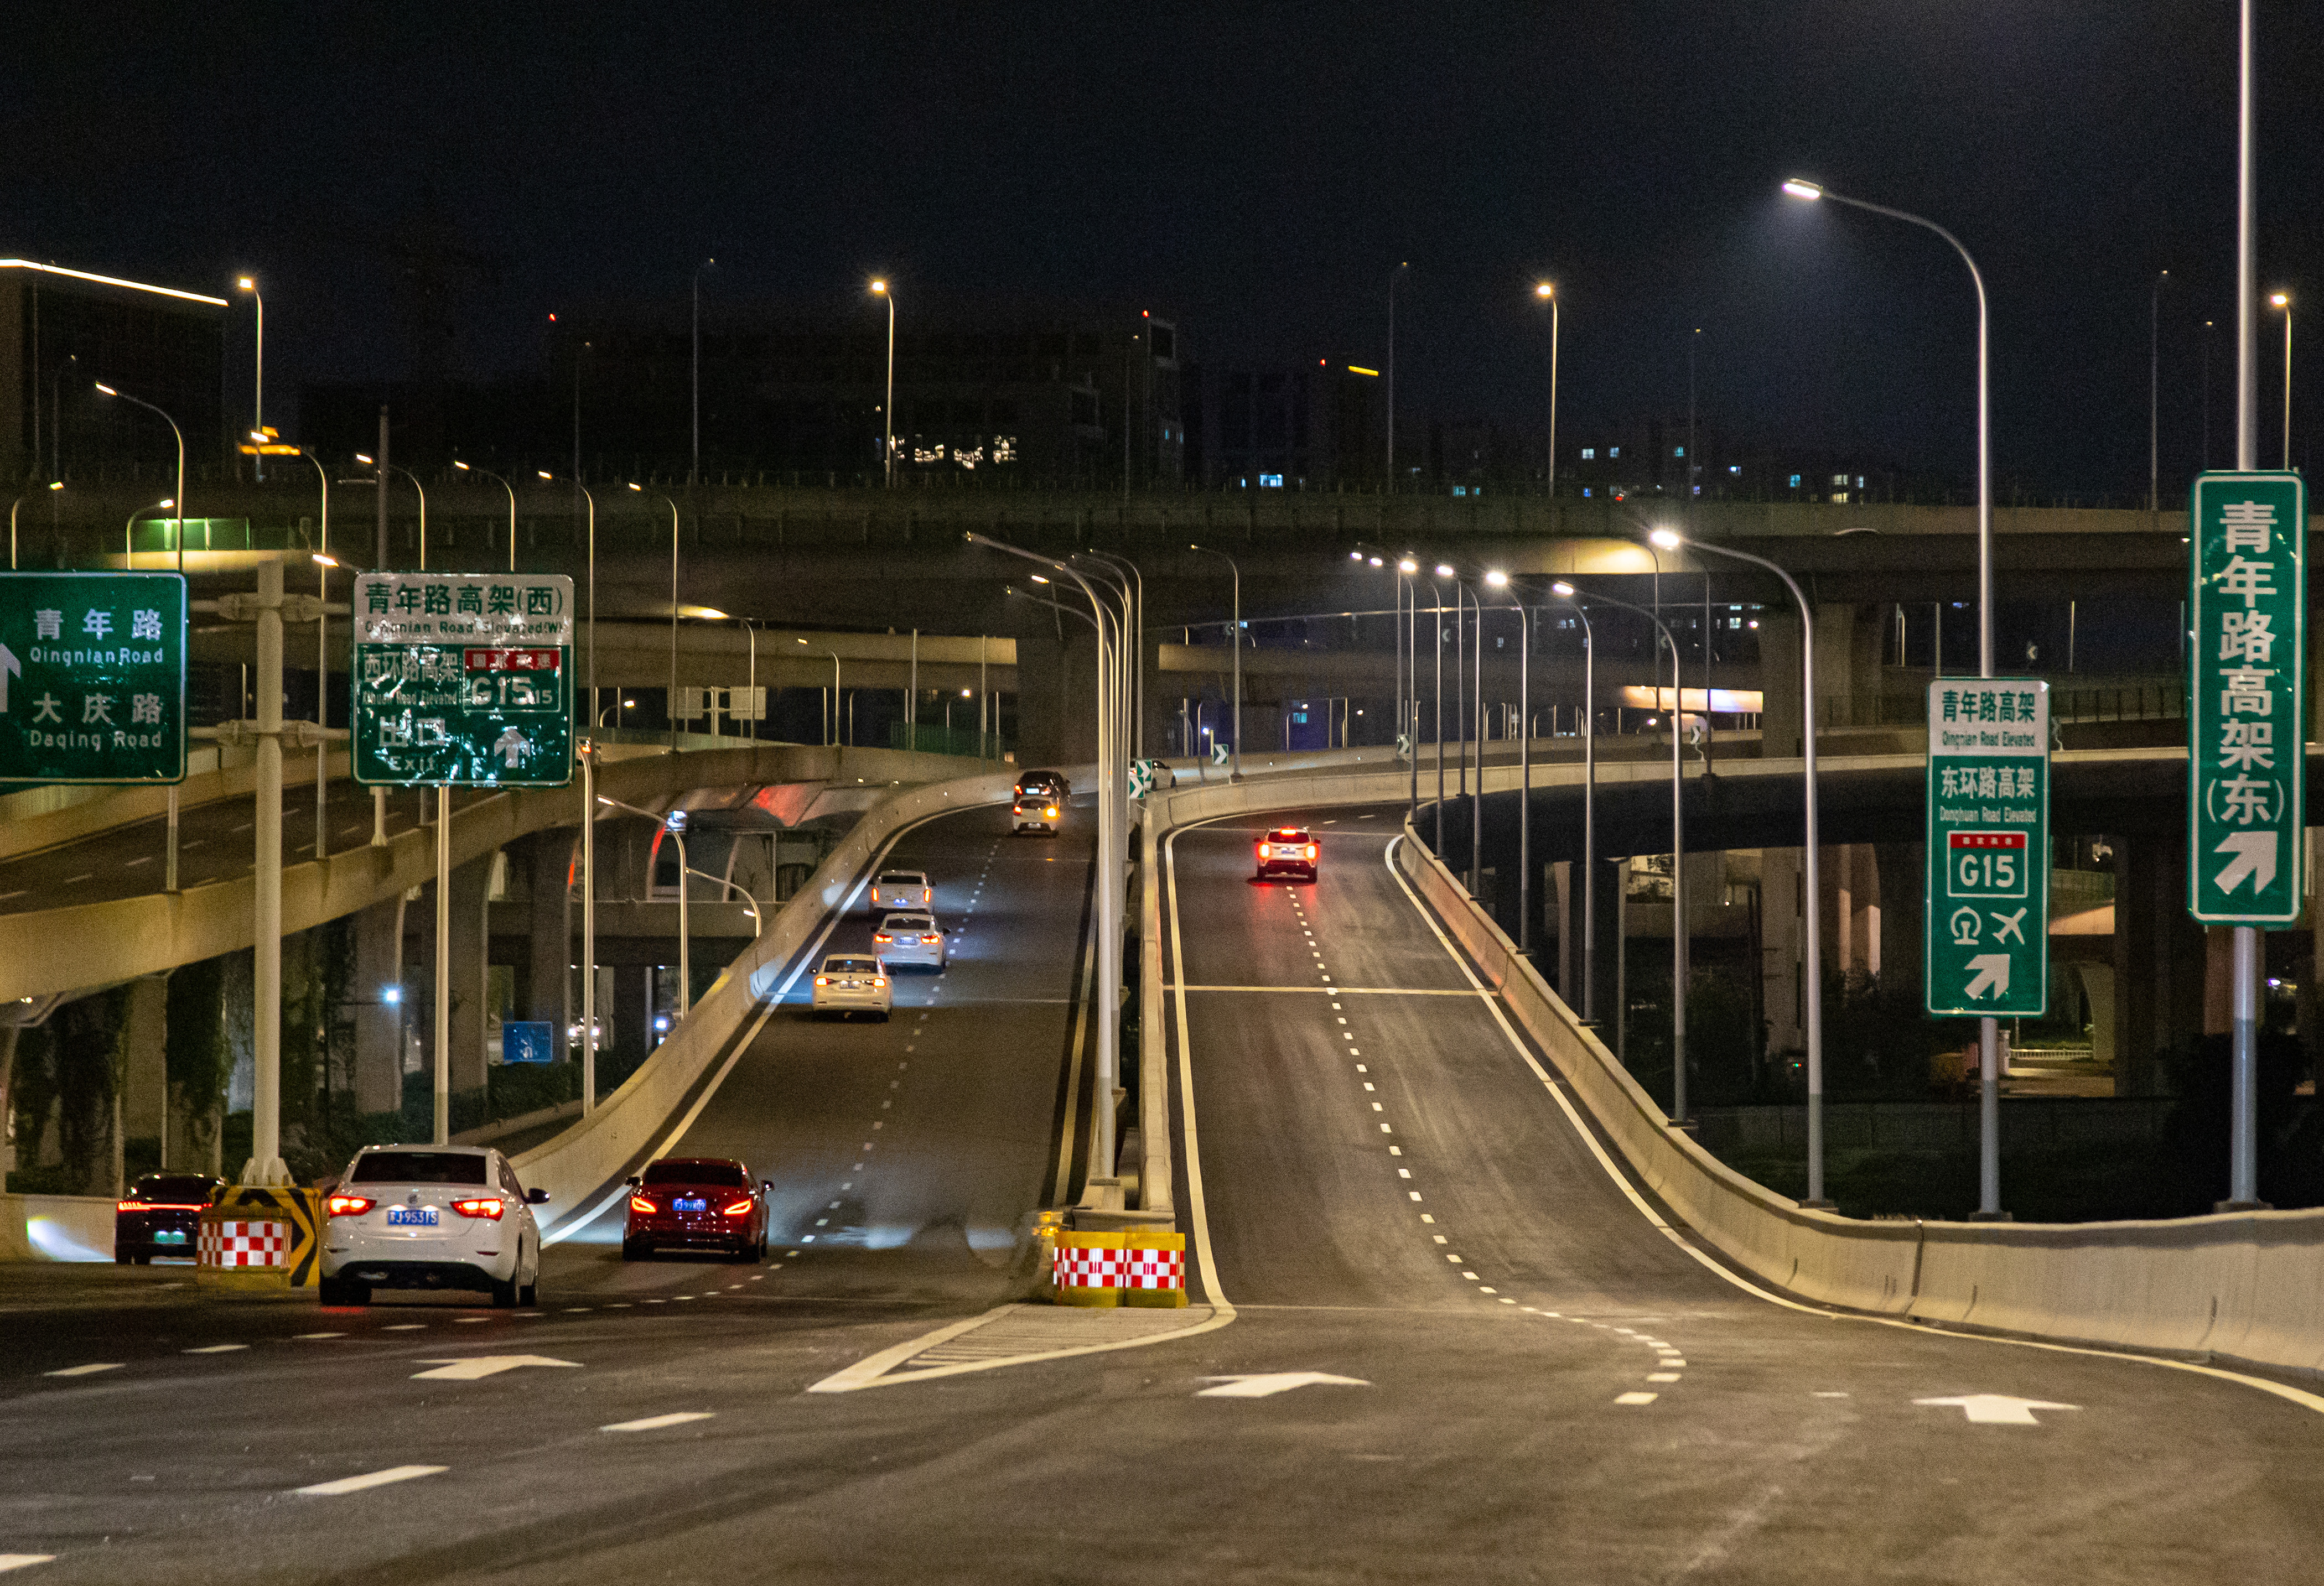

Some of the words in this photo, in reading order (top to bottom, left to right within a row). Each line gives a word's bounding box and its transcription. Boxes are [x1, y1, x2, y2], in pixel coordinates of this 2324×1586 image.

[365, 583, 563, 615] 青年路高架(西)
[34, 608, 163, 641] 青年路
[439, 621, 473, 633] Road
[30, 646, 116, 667] Qingnian
[120, 647, 163, 663] Road
[364, 651, 459, 683] 西环路高架
[2207, 500, 2284, 825] 青年路高架(东)
[32, 692, 164, 724] 大庆路
[1942, 689, 2036, 723] 青年路高架
[30, 729, 101, 752] Daqing
[113, 730, 162, 747] Road
[379, 715, 445, 748] 出口
[1941, 765, 2036, 799] 东环路高架
[1959, 854, 2015, 888] G15
